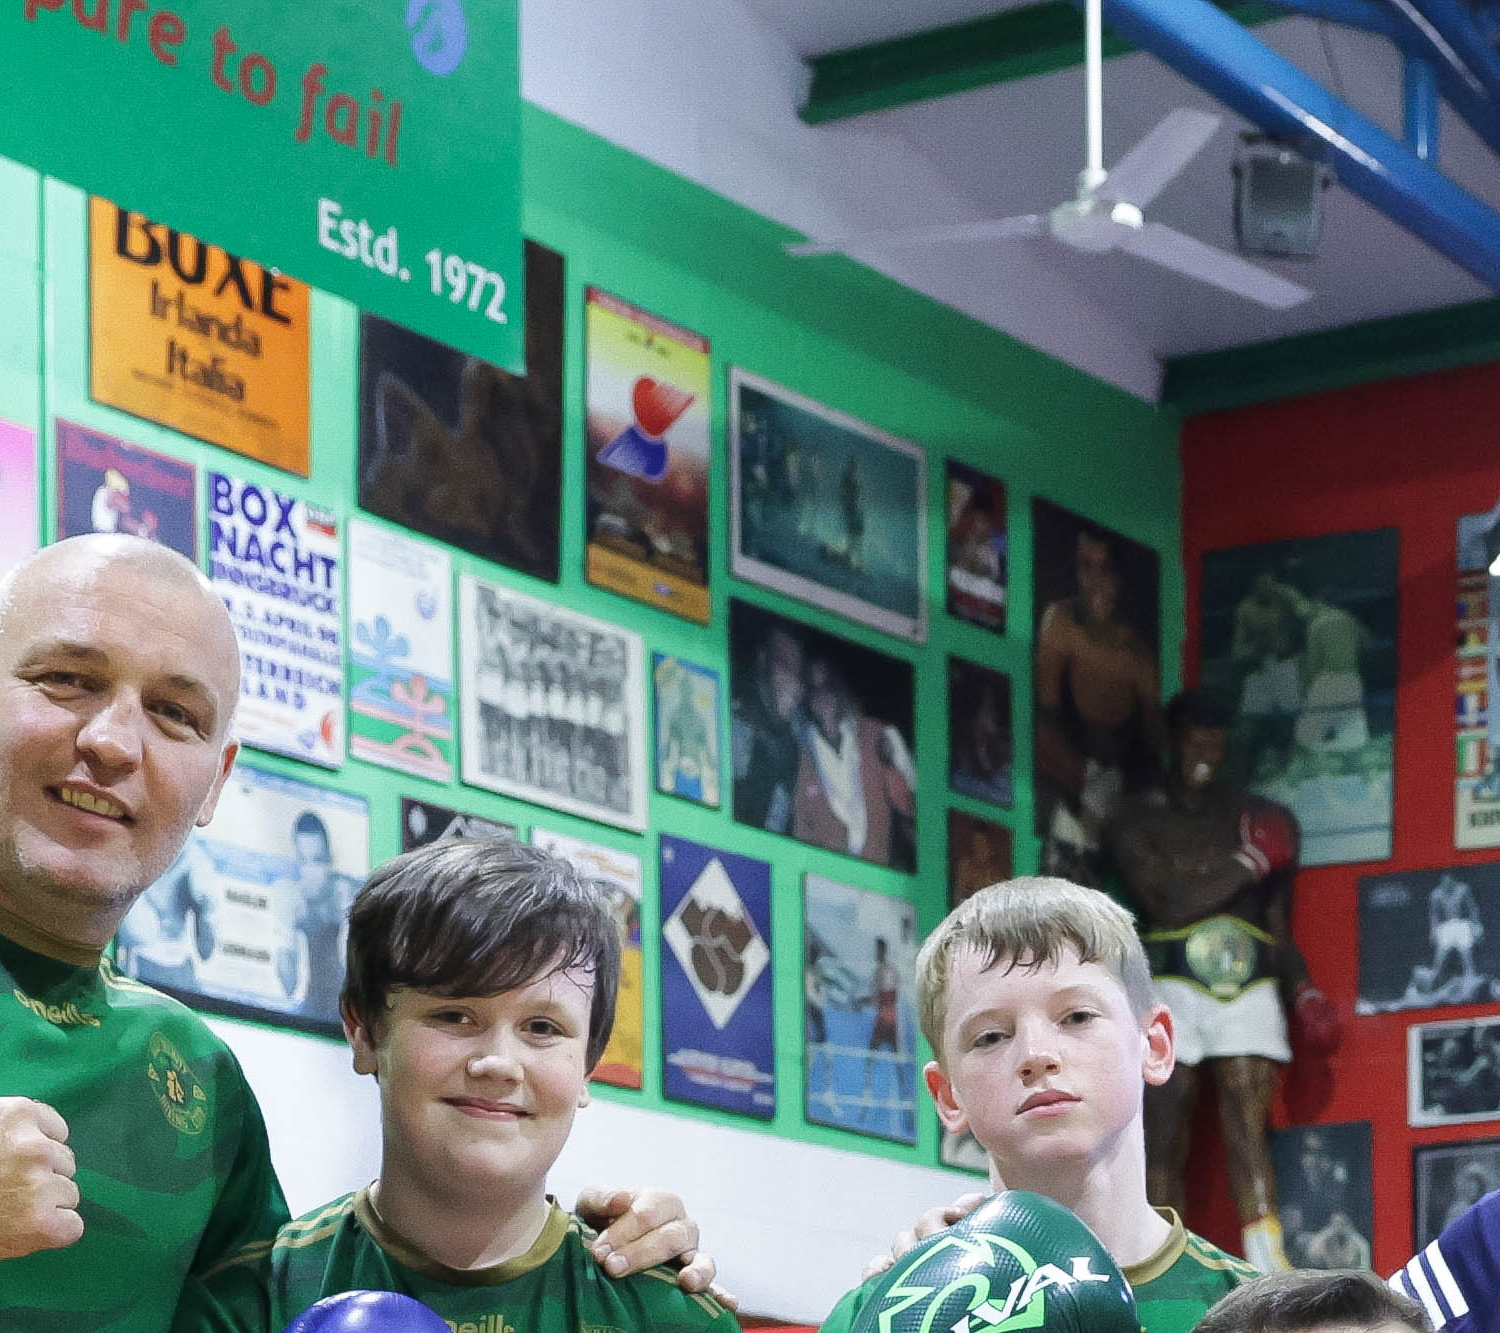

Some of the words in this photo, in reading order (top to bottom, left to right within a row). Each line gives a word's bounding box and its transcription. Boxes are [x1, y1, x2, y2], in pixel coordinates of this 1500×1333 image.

[212, 26, 277, 106] to
[297, 62, 400, 168] fail
[316, 197, 412, 284] Estd.
[424, 247, 510, 326] 1972
[150, 278, 265, 360] Irlanda
[165, 335, 247, 402] Italia
[209, 472, 296, 538] BOX
[209, 520, 336, 588] NACHT
